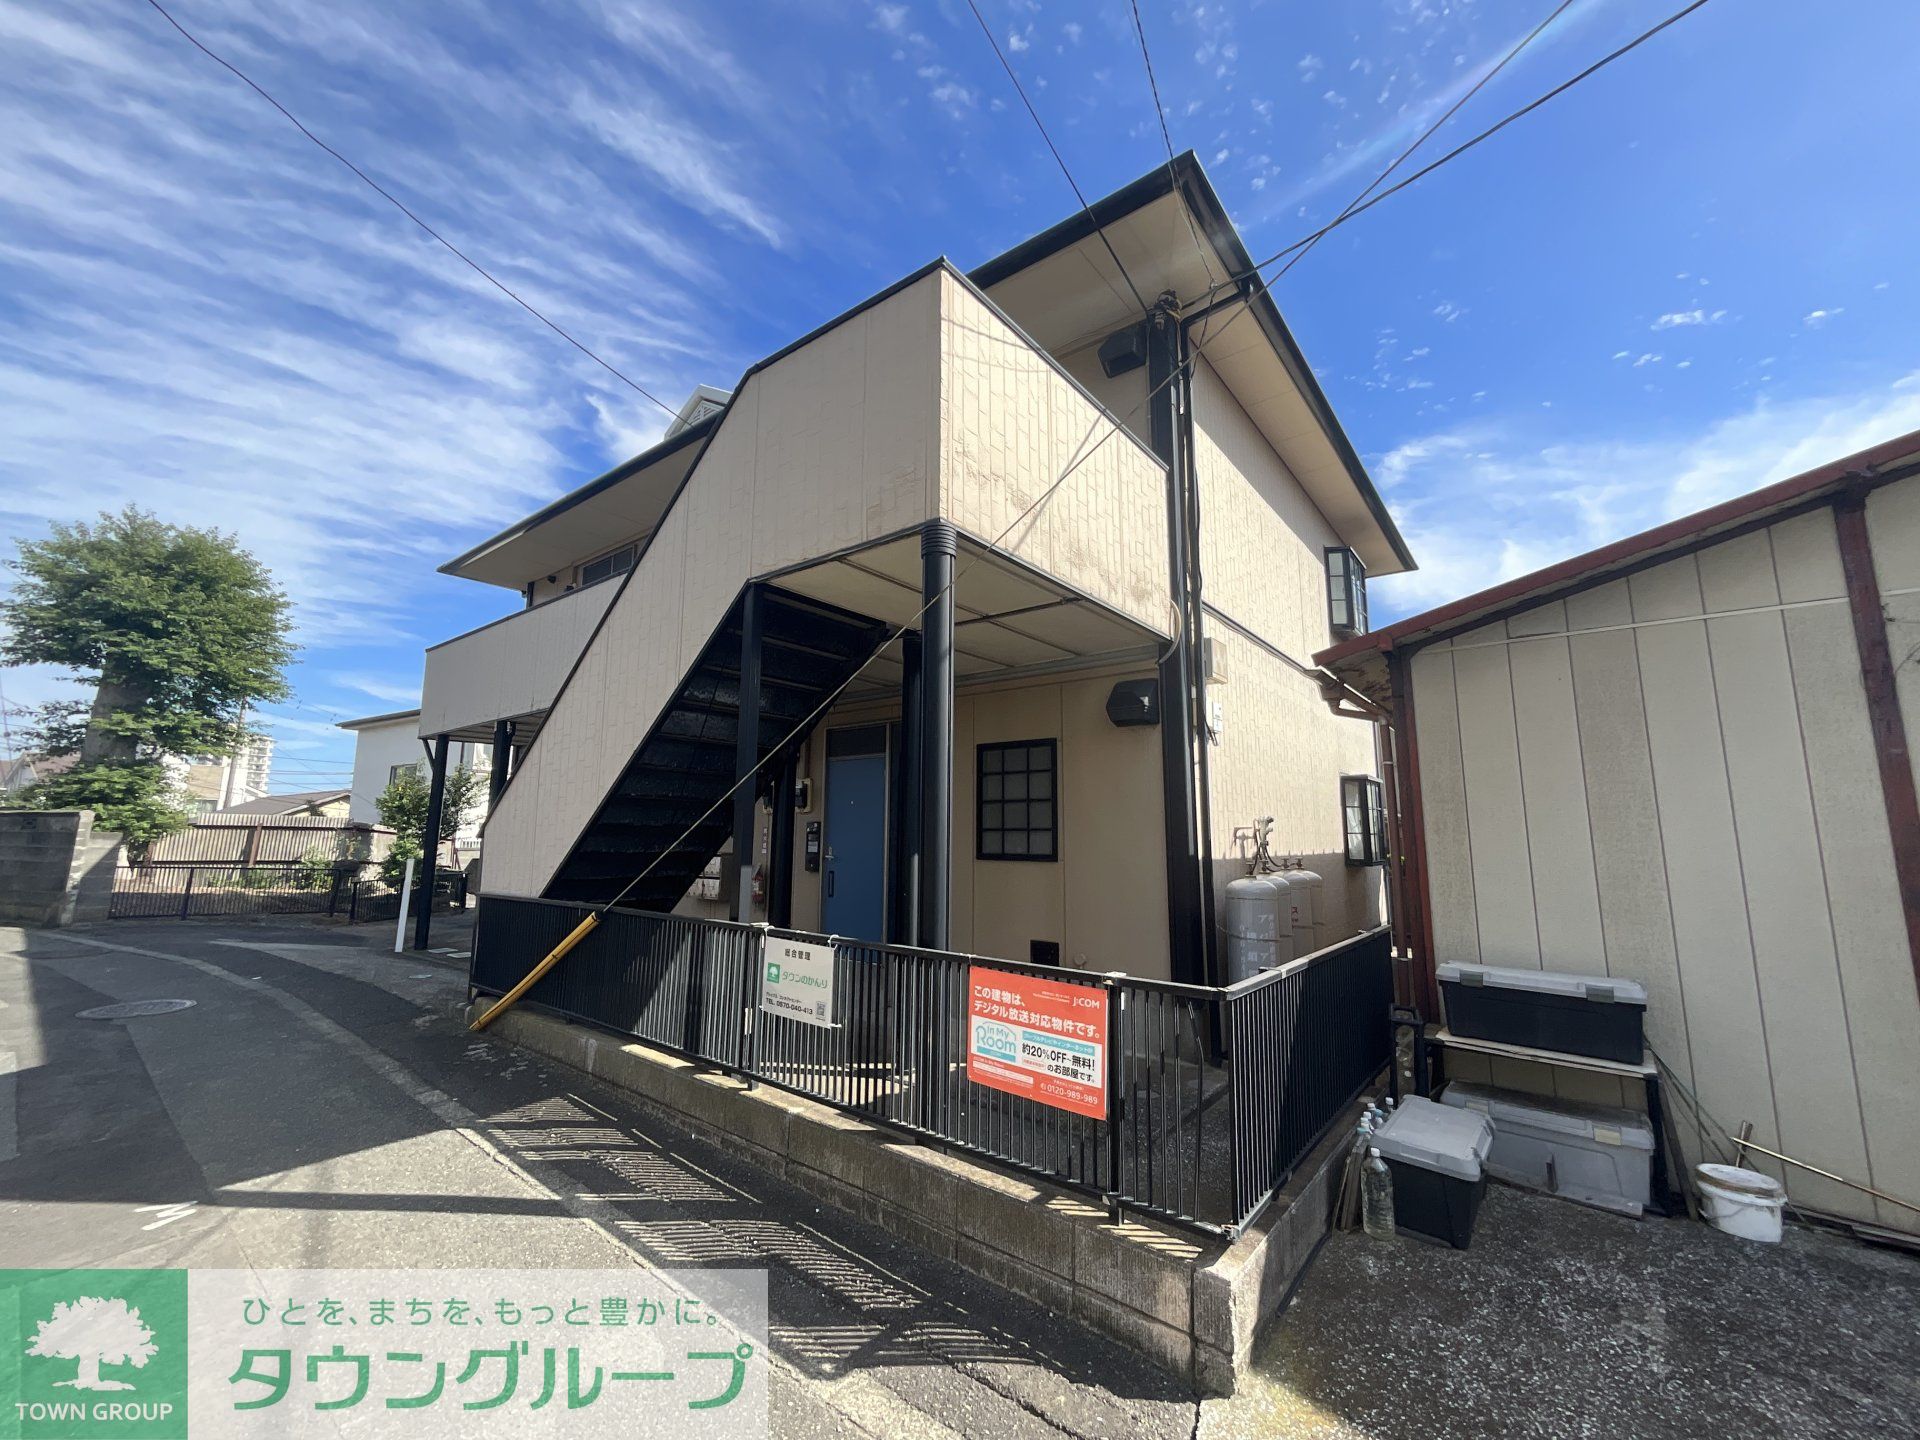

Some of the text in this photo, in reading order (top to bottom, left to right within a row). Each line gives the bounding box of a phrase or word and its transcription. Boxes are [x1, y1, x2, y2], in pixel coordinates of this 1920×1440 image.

[784, 948, 811, 961] 総合管理
[782, 971, 828, 989] タウンのかんり
[974, 985, 1026, 1007] この建物は、
[1072, 997, 1100, 1009] J:COM
[974, 1000, 1100, 1039] デジタル放送対応物件です。
[975, 1025, 1017, 1054] Room
[996, 1027, 1009, 1039] My
[1047, 1064, 1095, 1083] のお部屋です。
[1047, 1084, 1098, 1105] 0120-989-989
